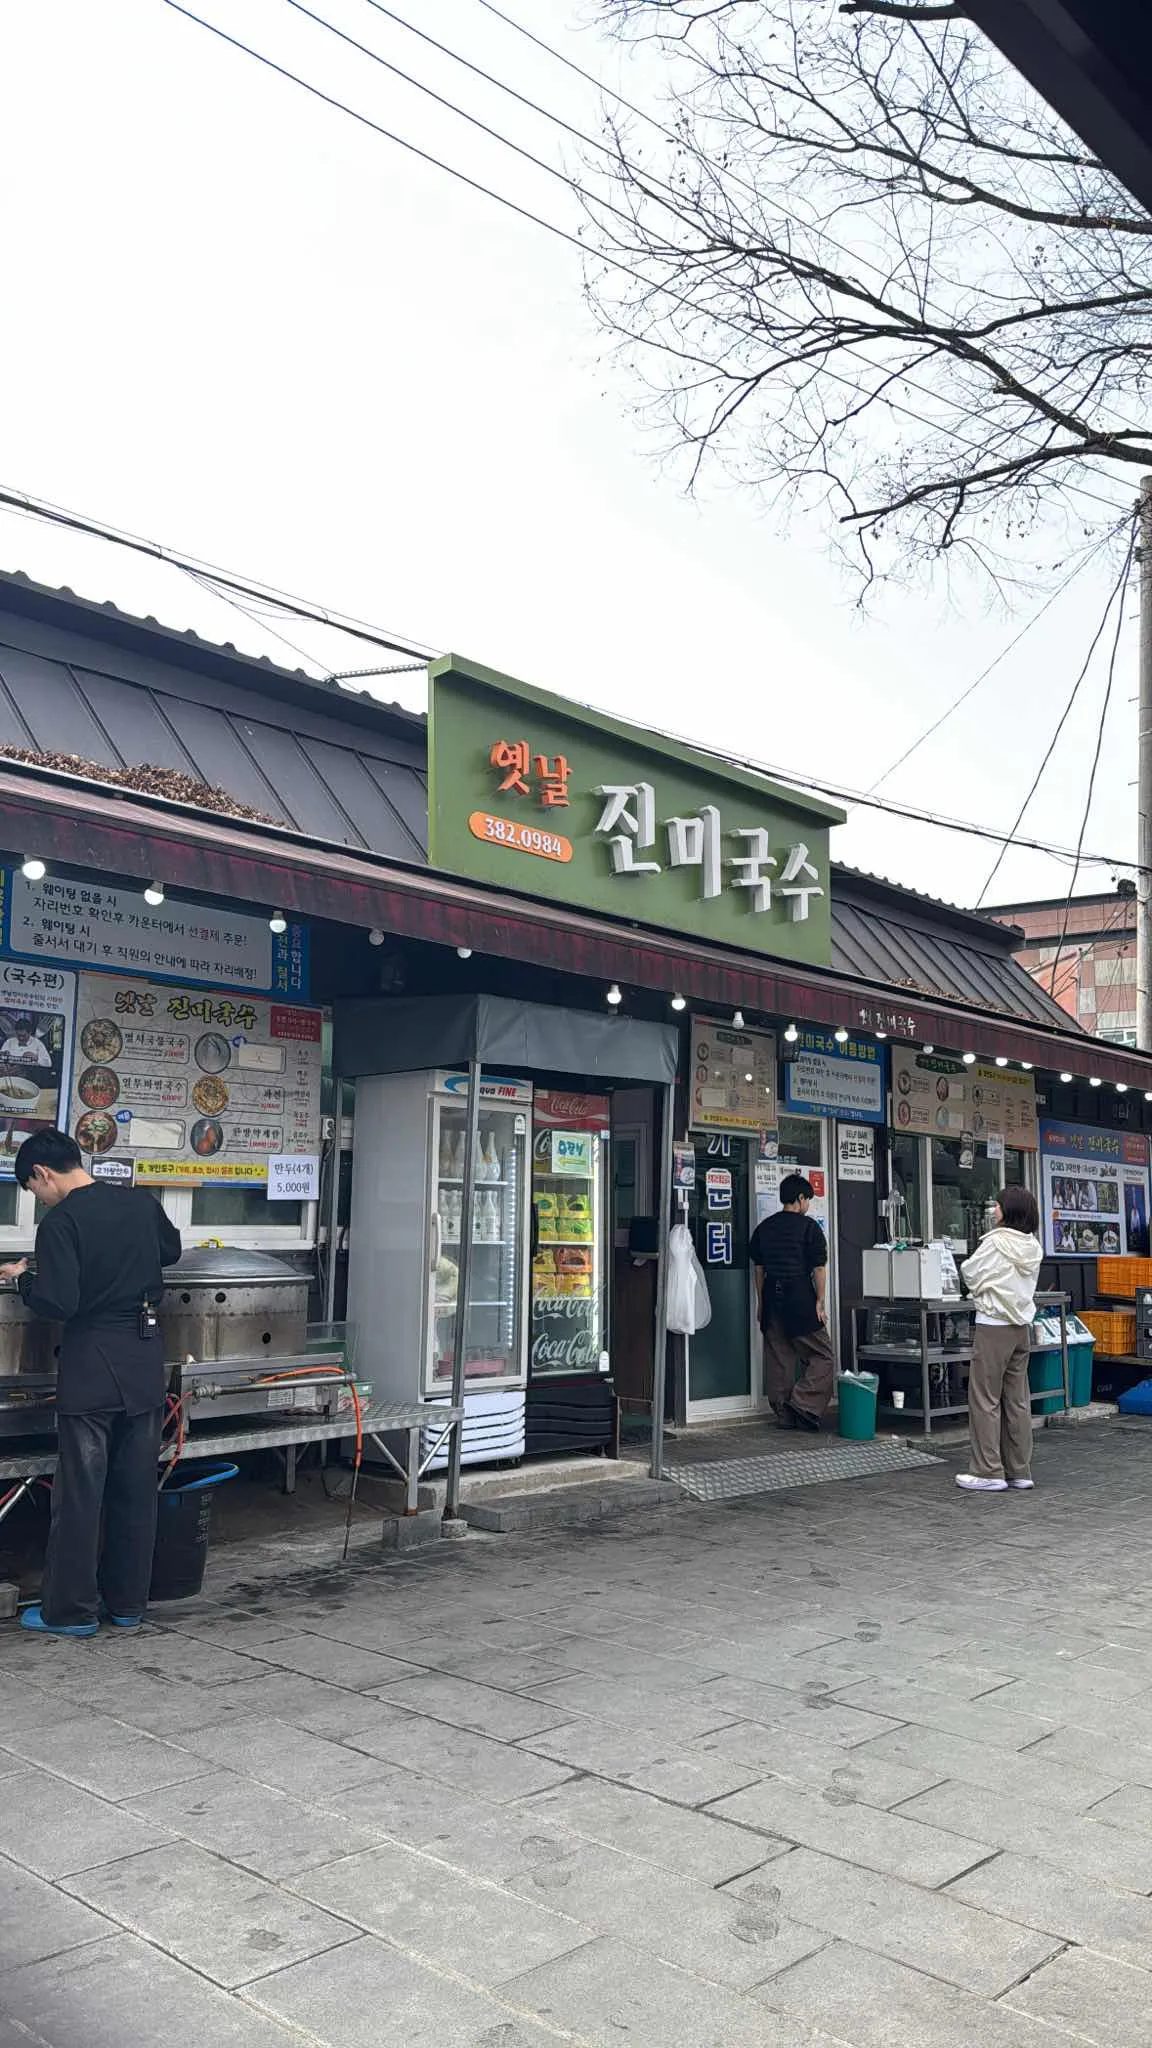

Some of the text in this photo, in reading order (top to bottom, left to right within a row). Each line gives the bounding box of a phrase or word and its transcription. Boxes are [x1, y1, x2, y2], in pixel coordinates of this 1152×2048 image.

[490, 740, 573, 807] 옛날
[483, 817, 562, 856] 382.0984
[593, 782, 824, 922] 진미국수
[25, 881, 35, 891] 1.
[42, 883, 76, 900] 웨이팅
[107, 896, 117, 907] 시
[23, 916, 91, 937] 2. 웨이팅 시
[33, 897, 83, 916] 자리번호
[88, 907, 123, 924] 확인후
[128, 913, 185, 936] 카운터에서
[223, 932, 248, 947] 주문!
[32, 933, 257, 981] 줄서서 대기 후 직원의 안내에 따라 자리배정!
[3, 966, 65, 990] (국수편)
[115, 990, 158, 1017] 옛날
[167, 995, 258, 1030] 진미국수
[497, 1087, 518, 1096] FINE
[551, 1097, 588, 1114] Coca-Cola
[839, 1141, 874, 1160] 셀프코너
[274, 1163, 314, 1175] 만두(4개)
